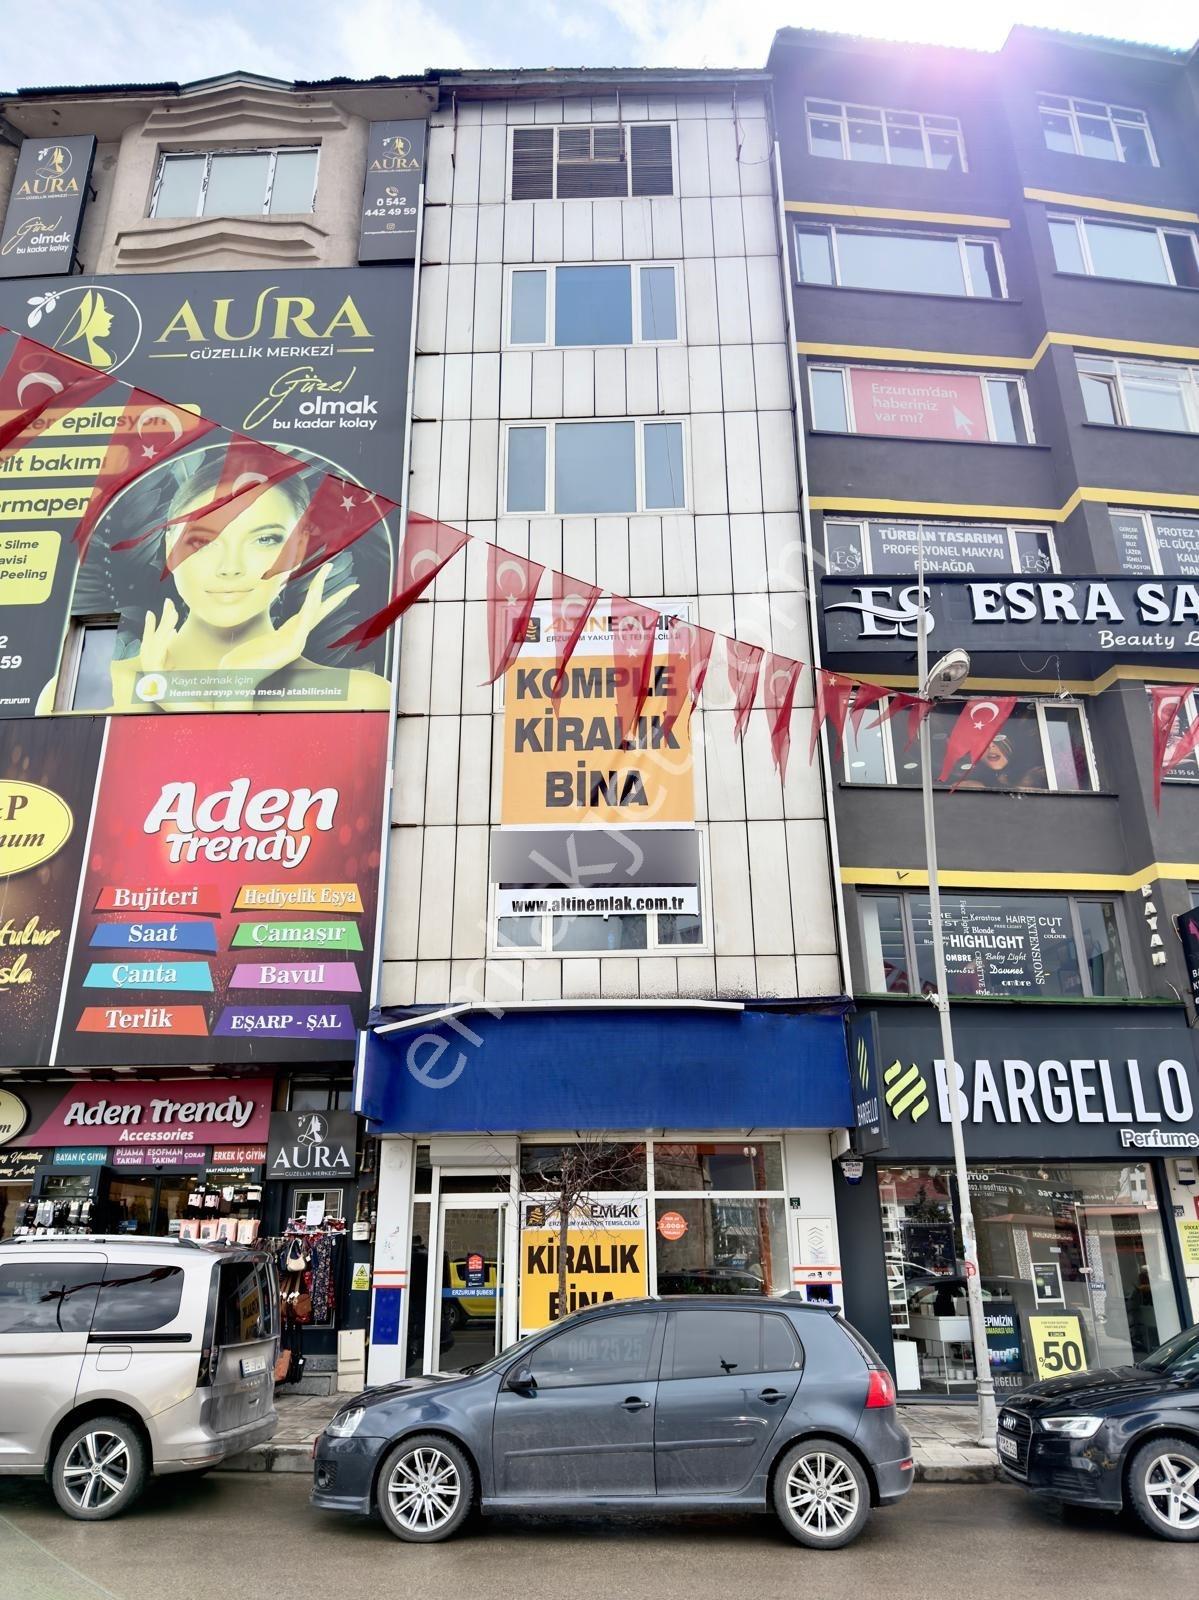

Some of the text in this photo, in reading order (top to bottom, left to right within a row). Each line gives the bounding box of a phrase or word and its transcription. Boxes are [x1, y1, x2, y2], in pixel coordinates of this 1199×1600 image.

[369, 157, 421, 170] AURA
[16, 176, 79, 195] AURA
[376, 197, 407, 207] 0 542
[364, 207, 417, 217] 442 49 59
[30, 232, 71, 244] olmak
[16, 244, 69, 254] bu kadar kolay
[153, 286, 375, 343] AURA
[189, 343, 335, 360] GÜZELLİK MERKEZİ
[243, 365, 357, 431] Güzel
[299, 395, 379, 415] olmak
[872, 395, 938, 411] haberiniz
[272, 416, 378, 431] bu kadar kolay
[874, 412, 897, 422] var
[0, 497, 92, 516] rmapen
[878, 528, 1004, 545] TÜRBAN TASARIMI
[1157, 526, 1195, 538] PROTEZ
[4, 539, 40, 549] Silme
[882, 543, 1004, 559] PROFESYONEL MAKYAJ
[1176, 553, 1199, 563] KALI
[914, 559, 975, 573] FÖN-AĞDA
[0, 569, 48, 581] Peeling
[968, 582, 1125, 624] ESRA
[852, 586, 935, 637] ES
[546, 634, 587, 643] ERZUM
[1097, 630, 1175, 649] Beauty
[0, 655, 22, 669] 59
[170, 675, 254, 687] Kayıt olmak için
[516, 665, 677, 700] KOMPLE
[169, 686, 343, 698] Hemen arayıp veya mesaj atabilirsiniz
[514, 707, 681, 753] KİRALIK
[545, 760, 649, 808] BİNA
[0, 794, 29, 821] P
[143, 777, 340, 835] Aden
[166, 828, 313, 869] Trendy
[113, 886, 200, 911] Bujiteri
[243, 888, 357, 908] Hediyelik Eşya
[511, 895, 684, 914] www.altinemlak.com.tr
[928, 919, 959, 927] BST
[1005, 915, 1027, 924] HAIR
[1038, 916, 1063, 927] CUT
[127, 923, 178, 943] Saat
[252, 924, 346, 946] Çamaşır
[971, 926, 995, 934] Blonde
[950, 934, 1025, 949] HIGHLIGHT
[1027, 915, 1046, 985] EXTENSIONS
[945, 954, 972, 962] OMBRE
[985, 952, 1027, 964] Baby Light
[112, 965, 178, 988] Çanta
[258, 964, 326, 985] Bavul
[105, 1007, 173, 1030] Terlik
[230, 1015, 292, 1033] EŞARP
[306, 1014, 342, 1032] ŞAL
[933, 1059, 1195, 1123] BARGELLO
[64, 1095, 254, 1128] Aden Trendy
[118, 1128, 194, 1142] Accessories
[1120, 1128, 1199, 1148] Perfume
[55, 1153, 78, 1162] BAYAN
[116, 1147, 144, 1157] PİJAMA
[147, 1148, 183, 1157] EŞOFMAN
[184, 1152, 205, 1160] ÇORAP
[213, 1149, 266, 1163] ERKEK İÇ GİYİM
[272, 1140, 351, 1168] AURA
[117, 1157, 142, 1165] TAKIMI
[151, 1157, 177, 1165] TAKIMI
[527, 1237, 640, 1274] KİRALIK
[984, 1314, 1013, 1327] EPİMİZİN
[992, 1376, 1023, 1387] RGELLO
